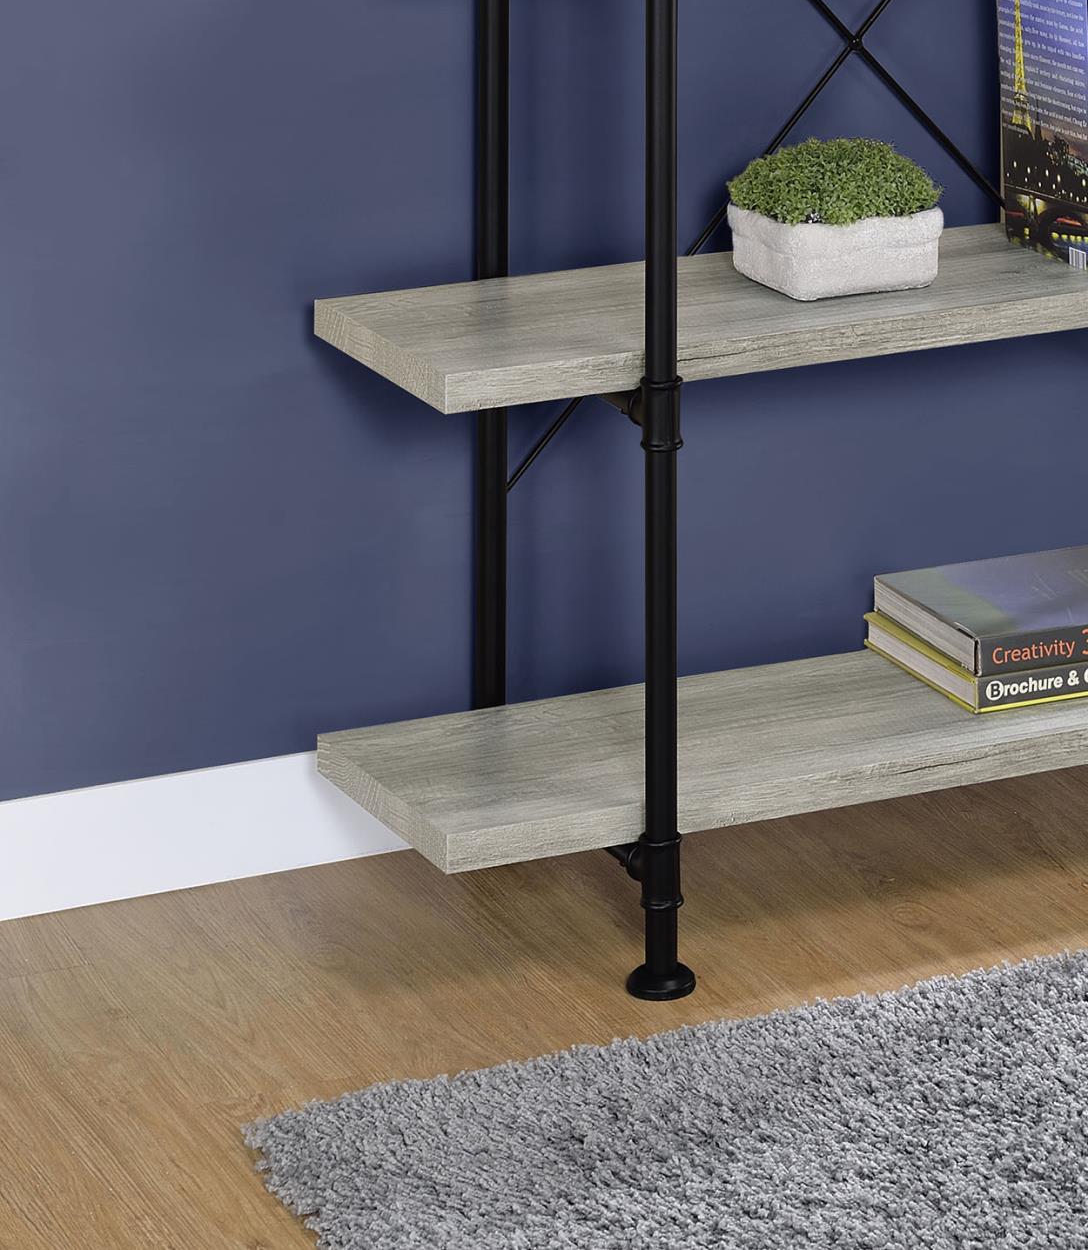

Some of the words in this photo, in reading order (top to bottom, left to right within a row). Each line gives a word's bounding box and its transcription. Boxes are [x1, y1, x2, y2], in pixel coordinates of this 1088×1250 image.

[991, 639, 1076, 664] Creativity
[986, 676, 1063, 700] Brochure
[1067, 669, 1080, 686] &
